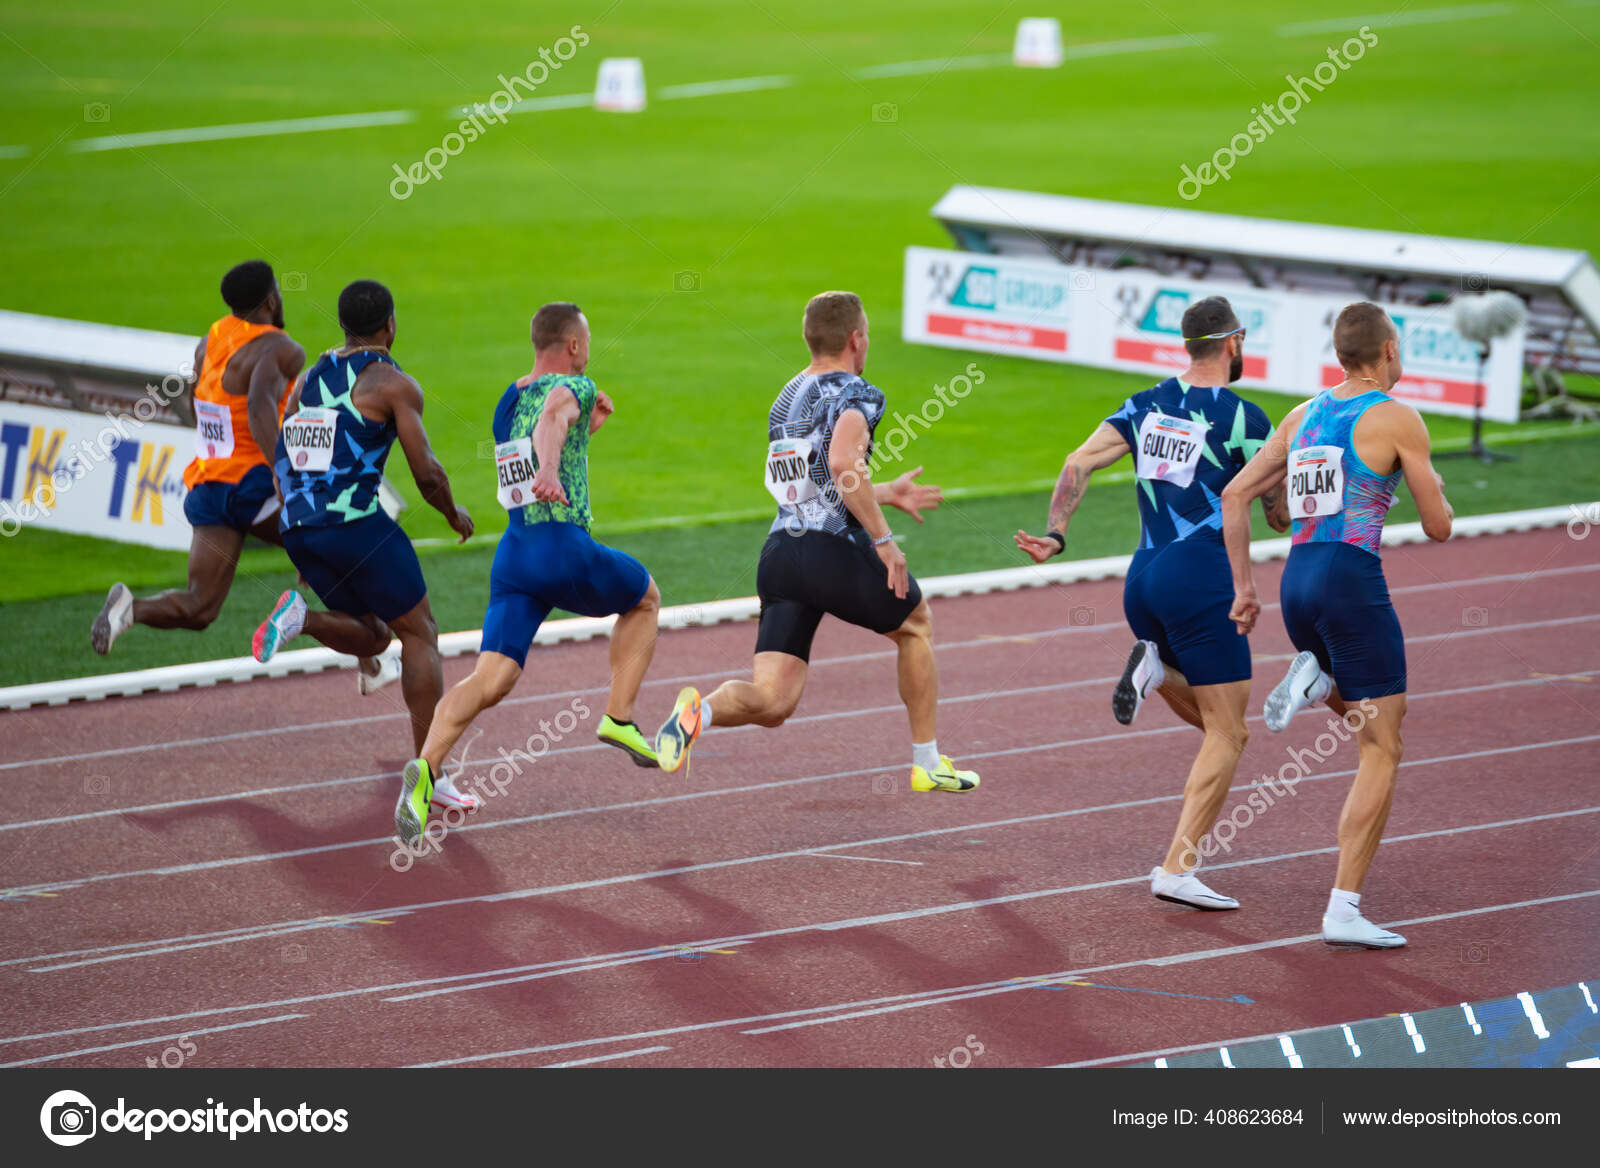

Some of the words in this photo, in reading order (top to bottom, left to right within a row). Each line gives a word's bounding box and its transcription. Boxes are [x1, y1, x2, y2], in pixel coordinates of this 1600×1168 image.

[285, 425, 333, 449] RODGERS
[1143, 432, 1197, 463] GULIYEV
[768, 456, 806, 483] VOLKO
[1290, 463, 1336, 498] POLÁK
